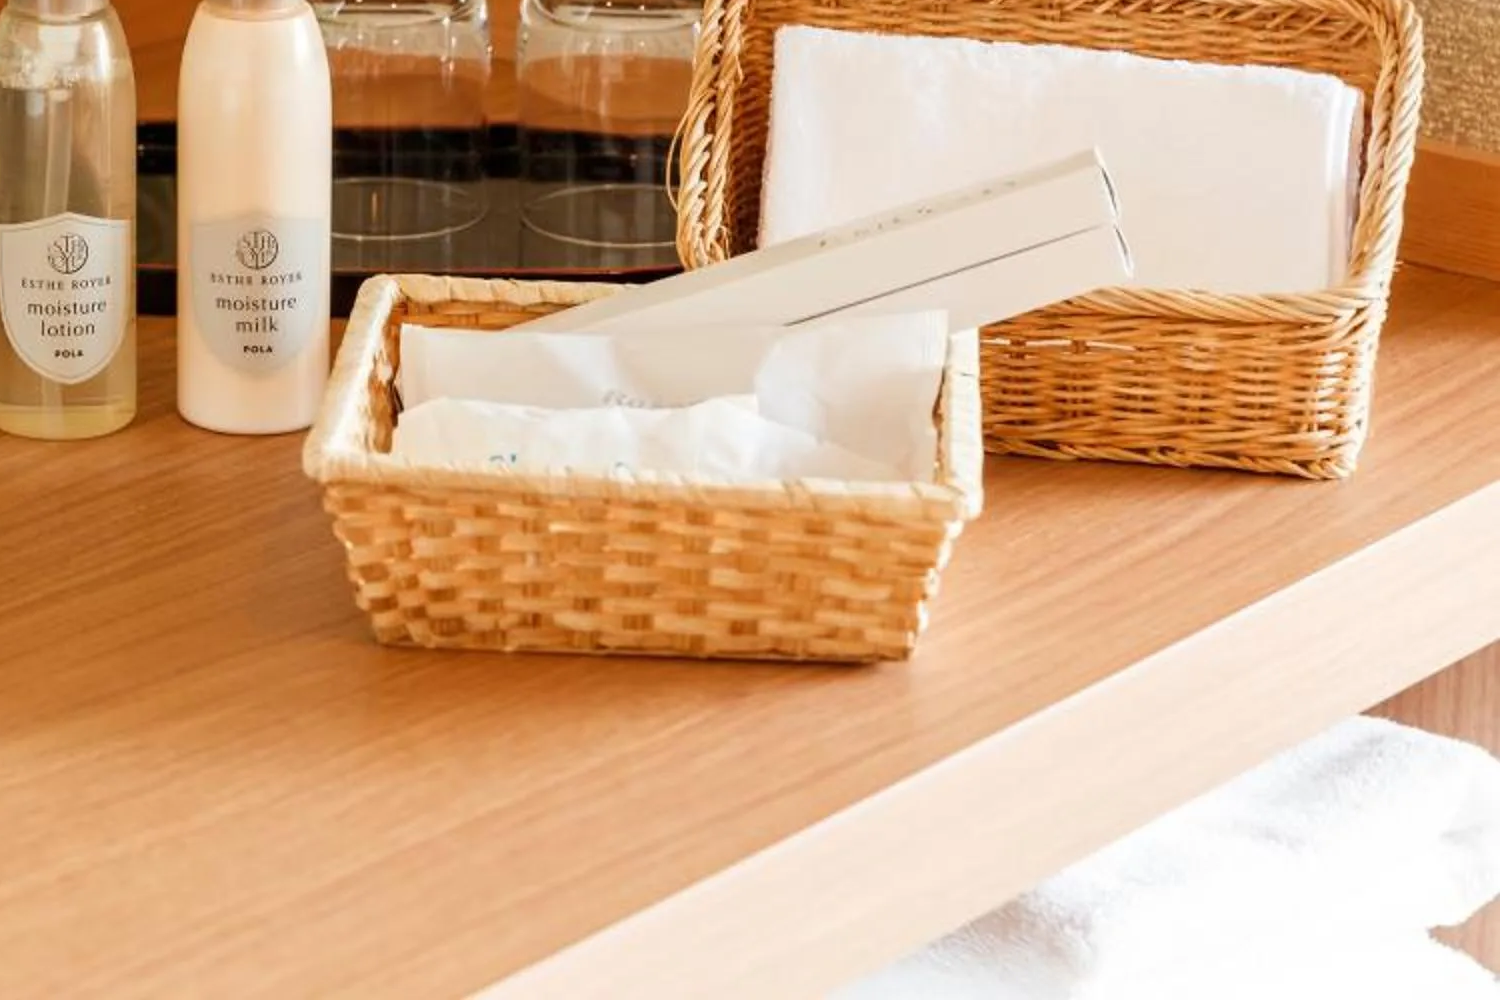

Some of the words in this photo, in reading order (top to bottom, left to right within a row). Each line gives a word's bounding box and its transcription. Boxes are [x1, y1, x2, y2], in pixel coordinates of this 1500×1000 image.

[21, 277, 65, 291] ESTHE
[71, 275, 111, 290] ROYER
[211, 272, 253, 286] ESTHE
[261, 271, 302, 286] ROYER
[27, 299, 107, 317] moisture
[215, 295, 297, 312] moisture
[41, 320, 95, 337] lotion
[235, 315, 279, 333] milk
[54, 349, 84, 359] POLA
[243, 345, 273, 354] POLA
